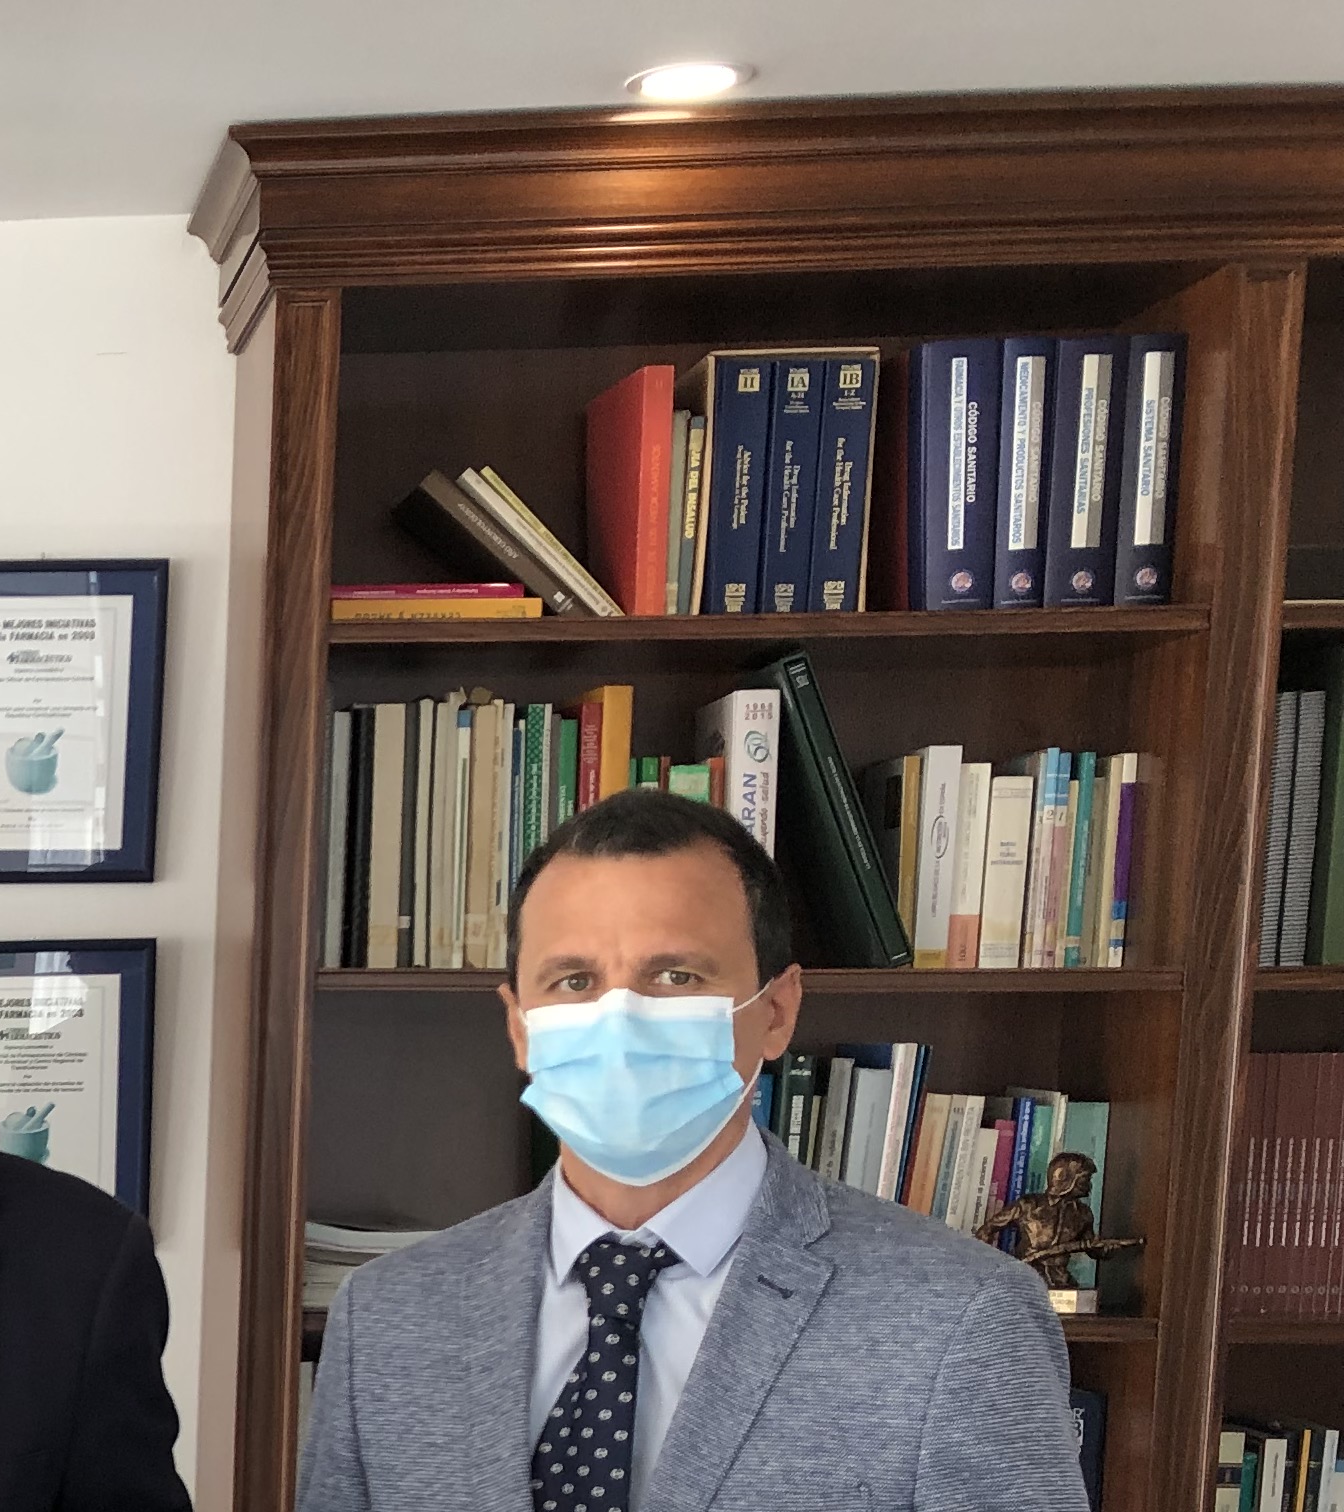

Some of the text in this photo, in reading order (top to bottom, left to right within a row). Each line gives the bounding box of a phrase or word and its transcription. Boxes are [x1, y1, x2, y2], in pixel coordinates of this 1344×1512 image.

[791, 374, 807, 388] IA
[843, 372, 860, 385] IB
[1017, 362, 1029, 427] MEDICAMENTO
[965, 402, 980, 502] CÓDIGO SANITARIO
[1014, 438, 1025, 491] PRODUCTOS
[1077, 387, 1094, 514] PROFESIONES SANITARIAS
[1091, 445, 1104, 502] SANITARIO
[1141, 399, 1155, 496] SISTEMA SANITARIO
[1012, 493, 1023, 543] SANITARIOS
